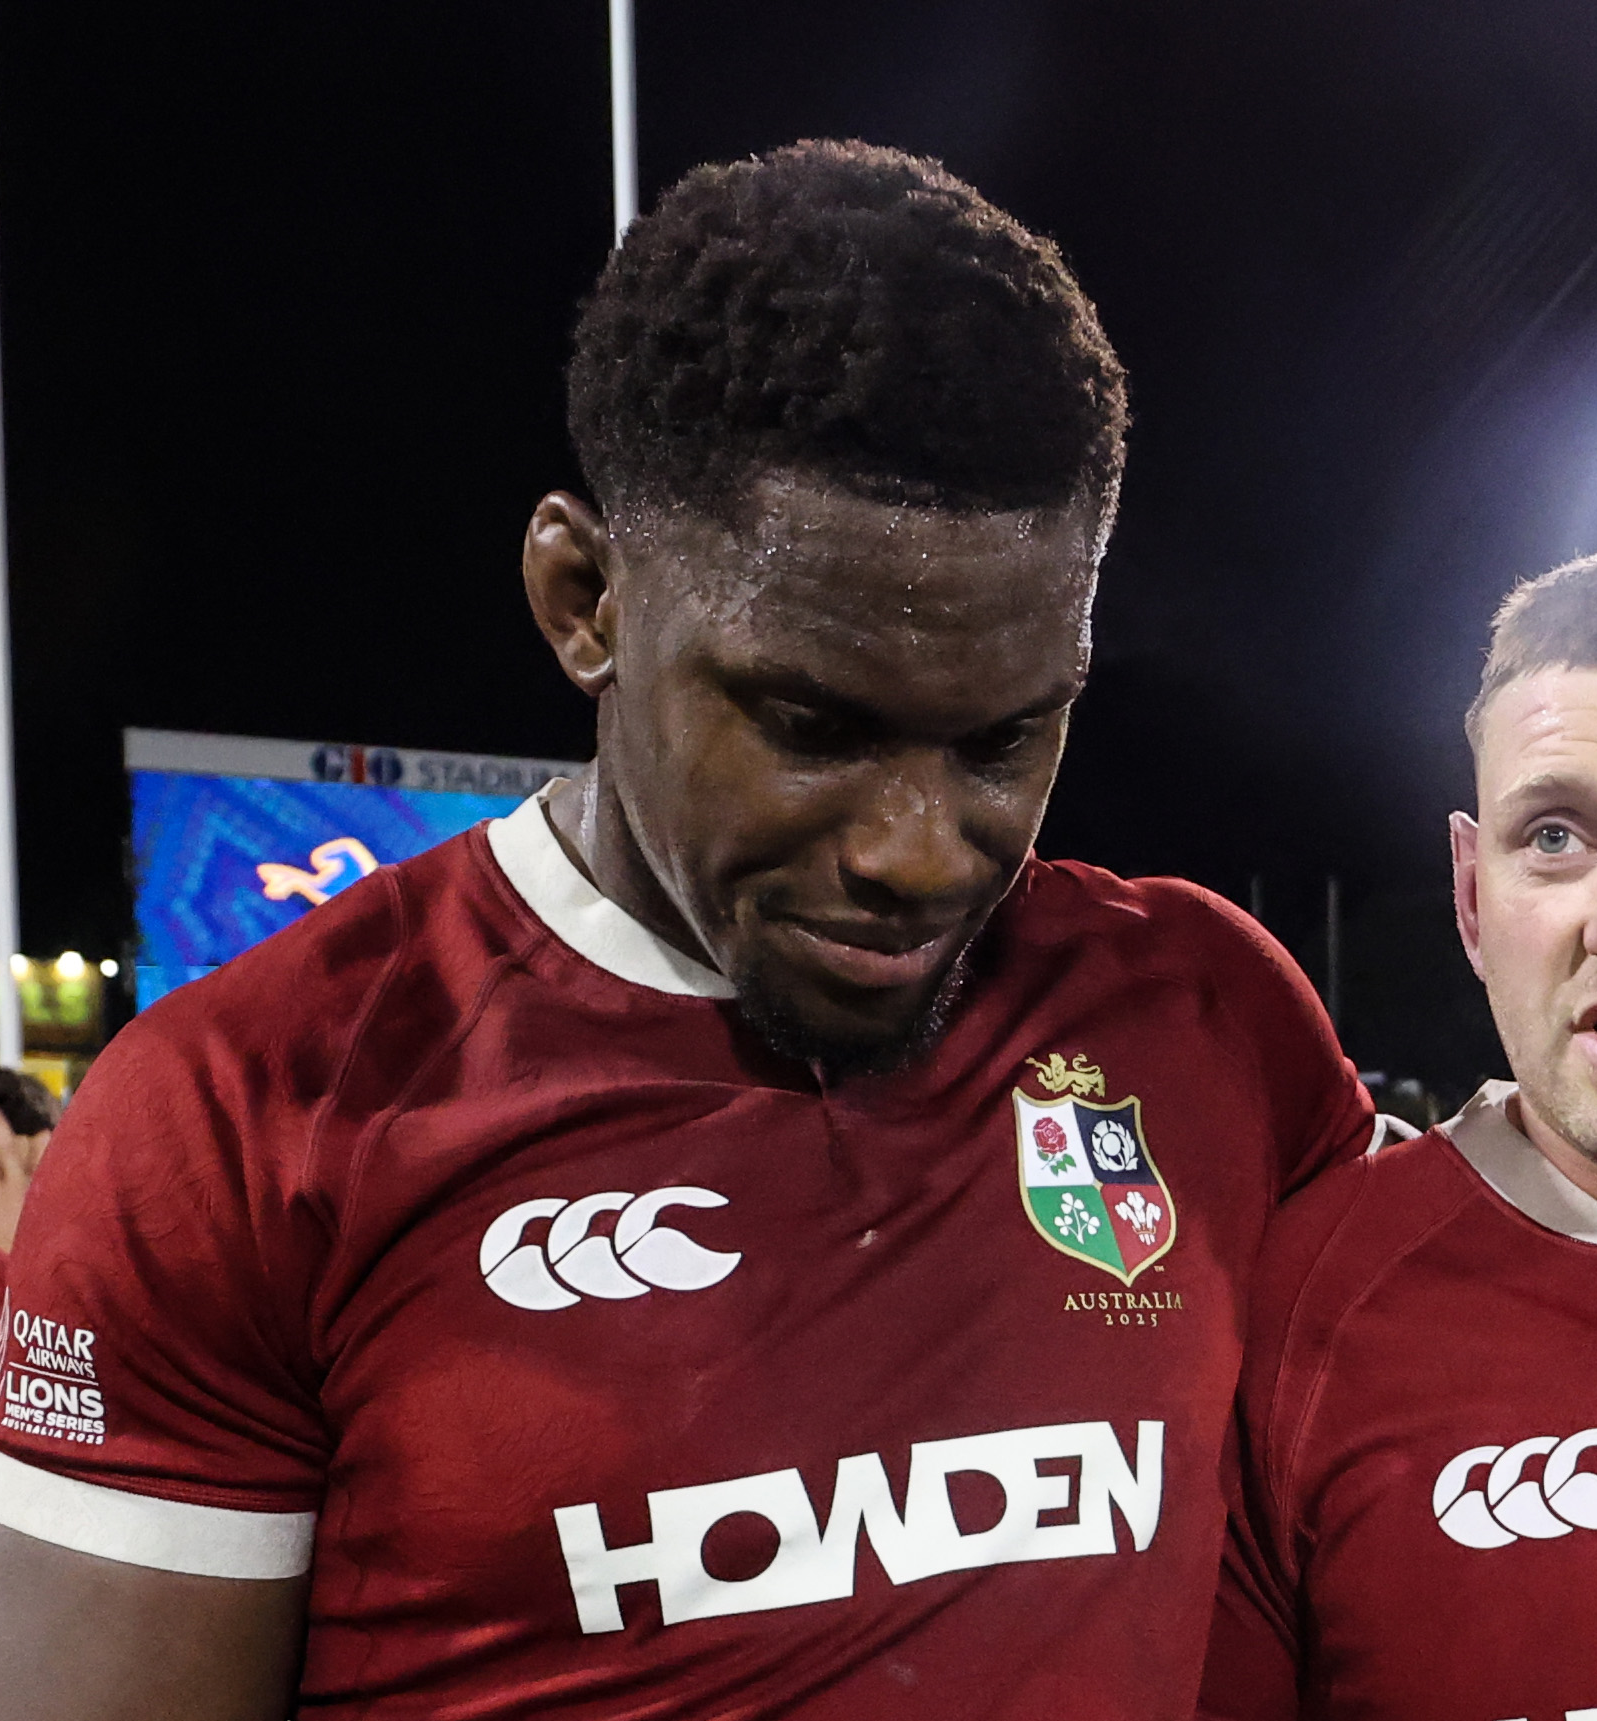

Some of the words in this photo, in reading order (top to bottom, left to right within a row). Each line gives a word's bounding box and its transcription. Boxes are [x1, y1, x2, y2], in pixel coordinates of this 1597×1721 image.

[418, 757, 567, 798] STADIU
[1063, 1292, 1183, 1311] AUSTRALIA
[13, 1309, 96, 1361] QATAR
[1105, 1313, 1159, 1327] 2025
[26, 1346, 95, 1379] AIRWAYS
[5, 1370, 105, 1418] LIONS
[1, 1417, 62, 1439] AUSTRALIA
[67, 1433, 104, 1445] 2025
[5, 1402, 45, 1426] MEN'S
[46, 1413, 105, 1435] SERIES
[553, 1419, 1165, 1635] HOWDEN
